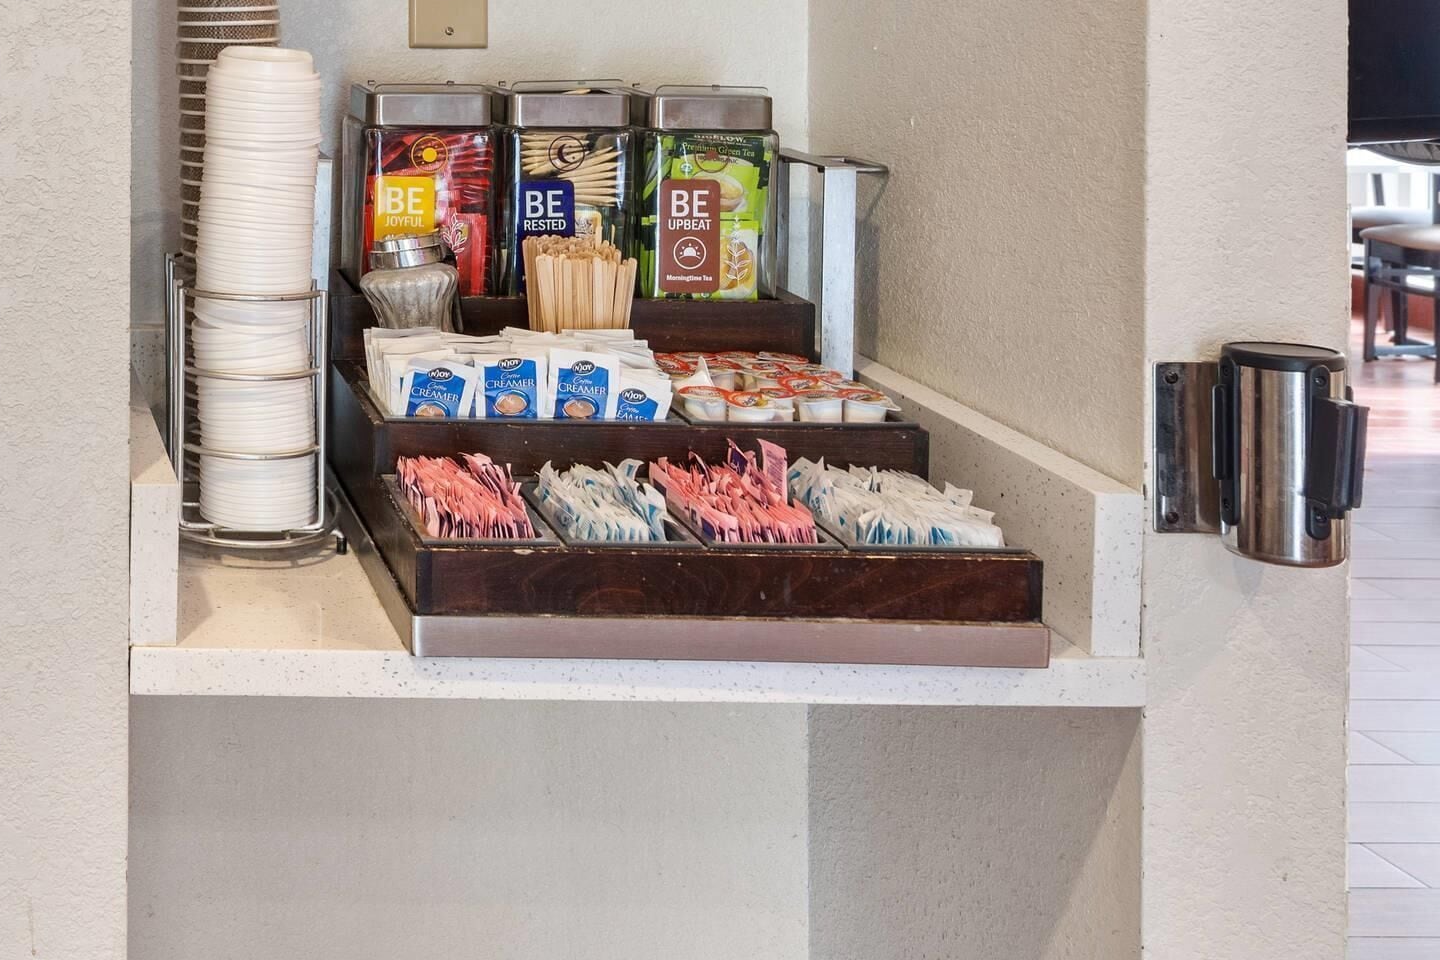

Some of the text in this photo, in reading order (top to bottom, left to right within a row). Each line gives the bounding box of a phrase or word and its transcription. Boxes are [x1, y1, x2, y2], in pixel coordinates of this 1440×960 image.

[718, 145, 740, 156] Green
[742, 148, 755, 157] Tea
[386, 186, 425, 215] BE
[525, 190, 564, 218] BE
[671, 190, 709, 218] BE
[384, 215, 425, 228] JOYFUL
[523, 219, 567, 231] RESTED
[668, 219, 712, 231] UPBEAT
[666, 274, 713, 282] Morningtime Tea
[485, 378, 535, 389] CREAMER
[558, 382, 606, 395] CREAMER
[411, 386, 459, 403] CREAMER
